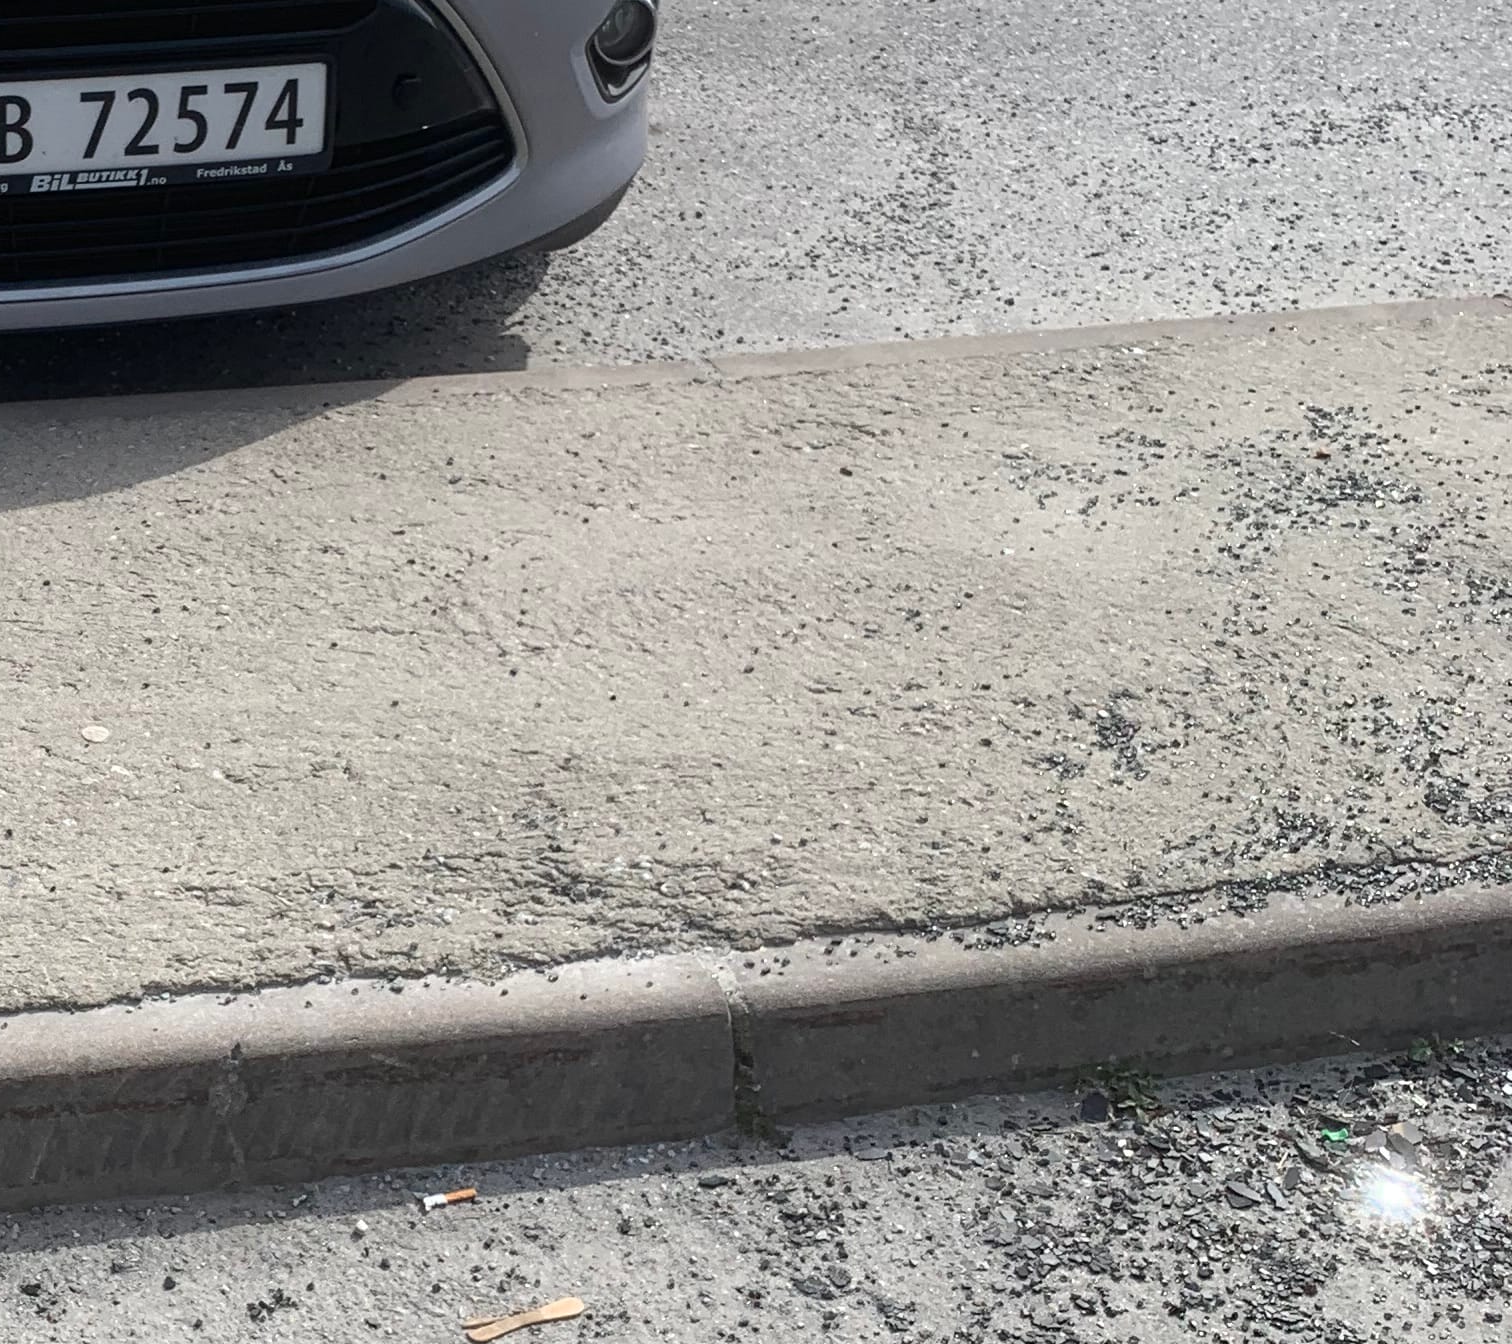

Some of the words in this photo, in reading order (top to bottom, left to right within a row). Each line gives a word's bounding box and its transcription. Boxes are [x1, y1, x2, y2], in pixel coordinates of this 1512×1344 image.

[80, 77, 304, 160] 72574
[196, 162, 268, 179] Fredrikstad
[277, 160, 293, 172] Ås
